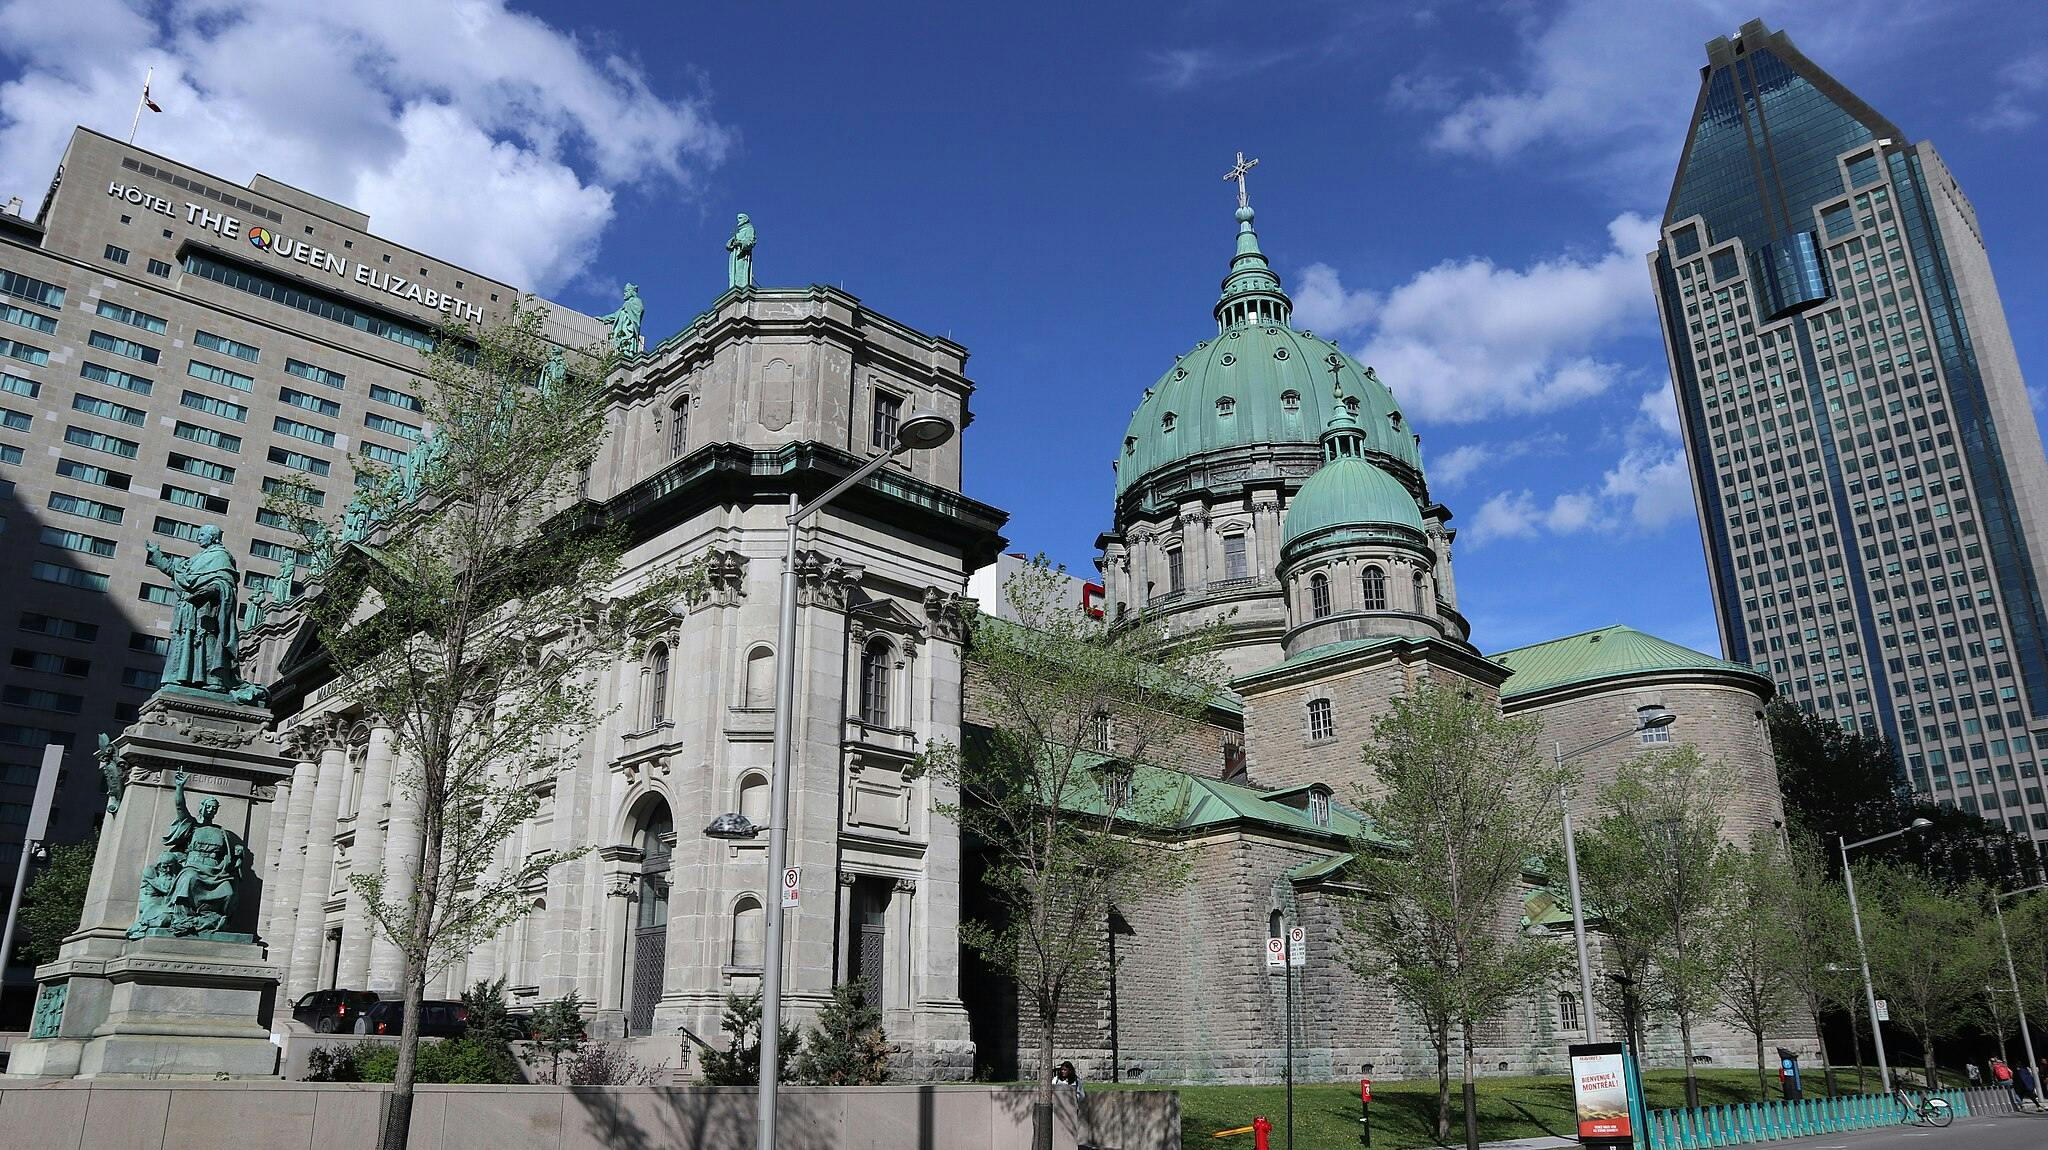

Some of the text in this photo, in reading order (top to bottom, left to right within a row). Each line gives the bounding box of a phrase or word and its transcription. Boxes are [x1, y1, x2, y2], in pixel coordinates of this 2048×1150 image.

[108, 181, 175, 217] HÔTEL
[185, 202, 240, 239] THE
[249, 226, 347, 276] QUEEN
[355, 263, 483, 324] ELIZABETH
[188, 774, 229, 787] ELIGION
[1581, 1073, 1610, 1083] BIENVENUE
